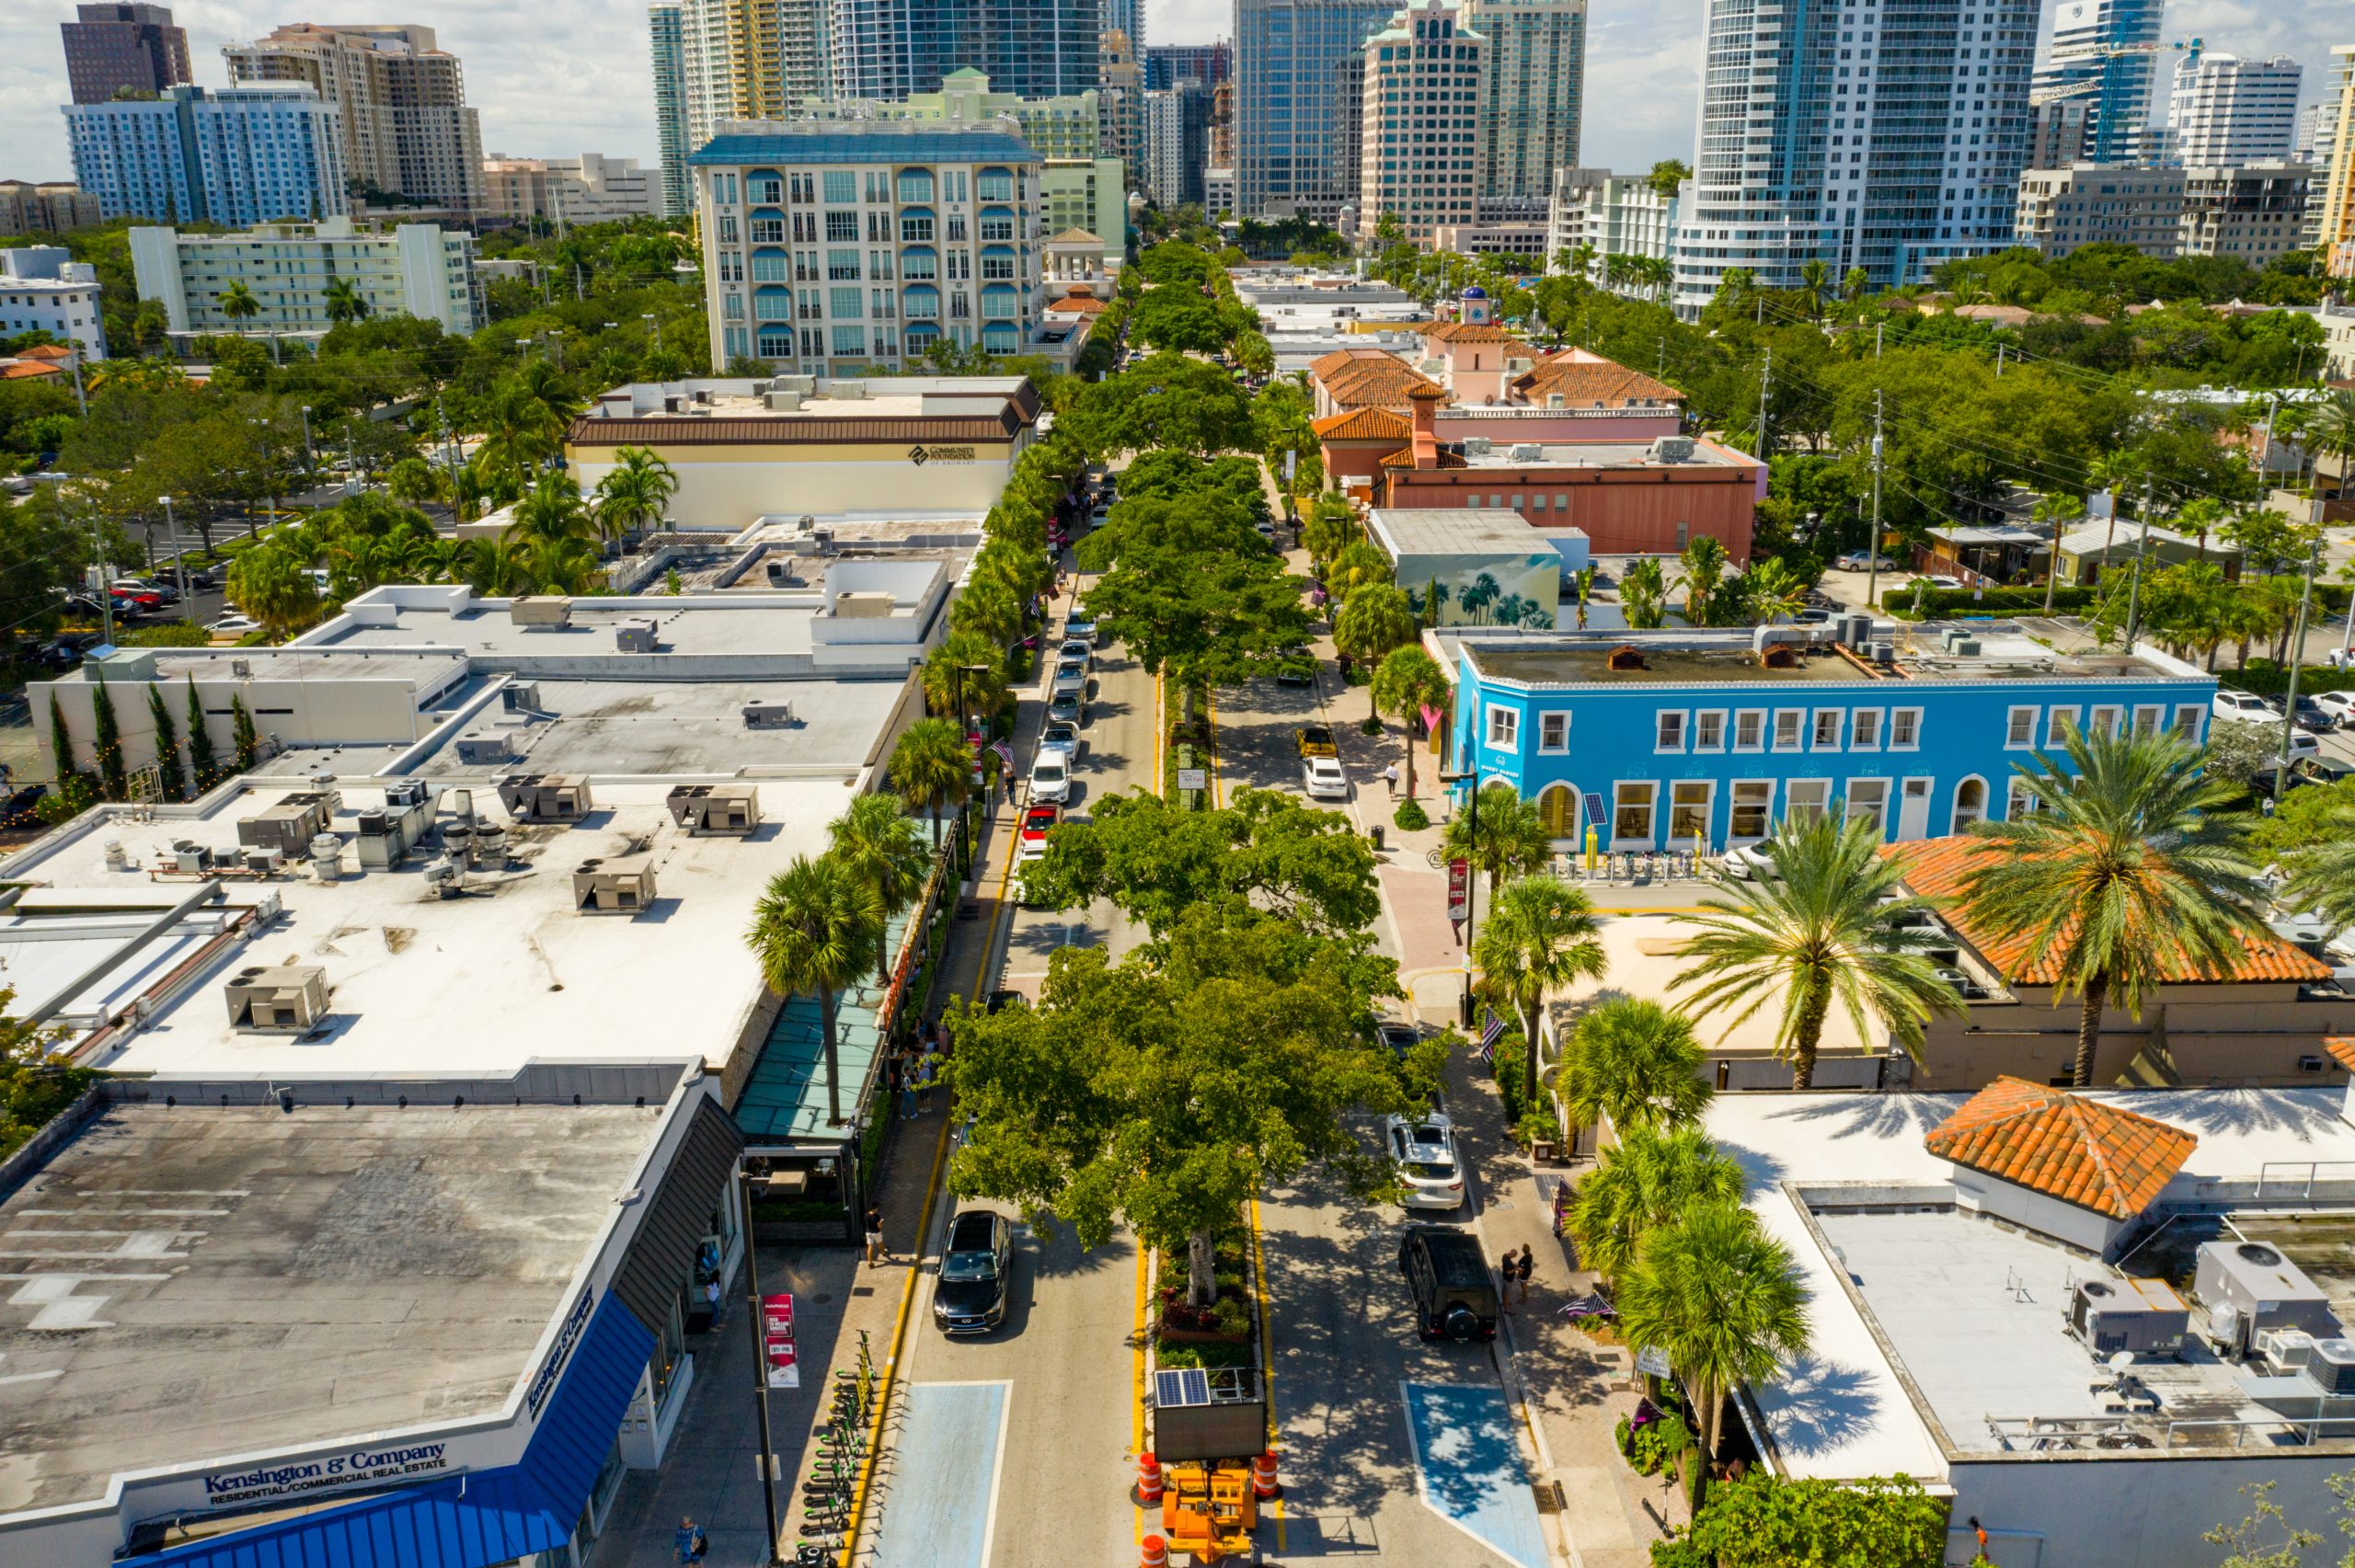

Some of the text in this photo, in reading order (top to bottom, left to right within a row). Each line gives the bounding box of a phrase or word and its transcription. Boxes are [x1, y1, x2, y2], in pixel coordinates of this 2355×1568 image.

[204, 1444, 446, 1493] Kensington & Company
[211, 1459, 446, 1505] RESIDENTIAL/COMMERCIAL REAL ESTATE
